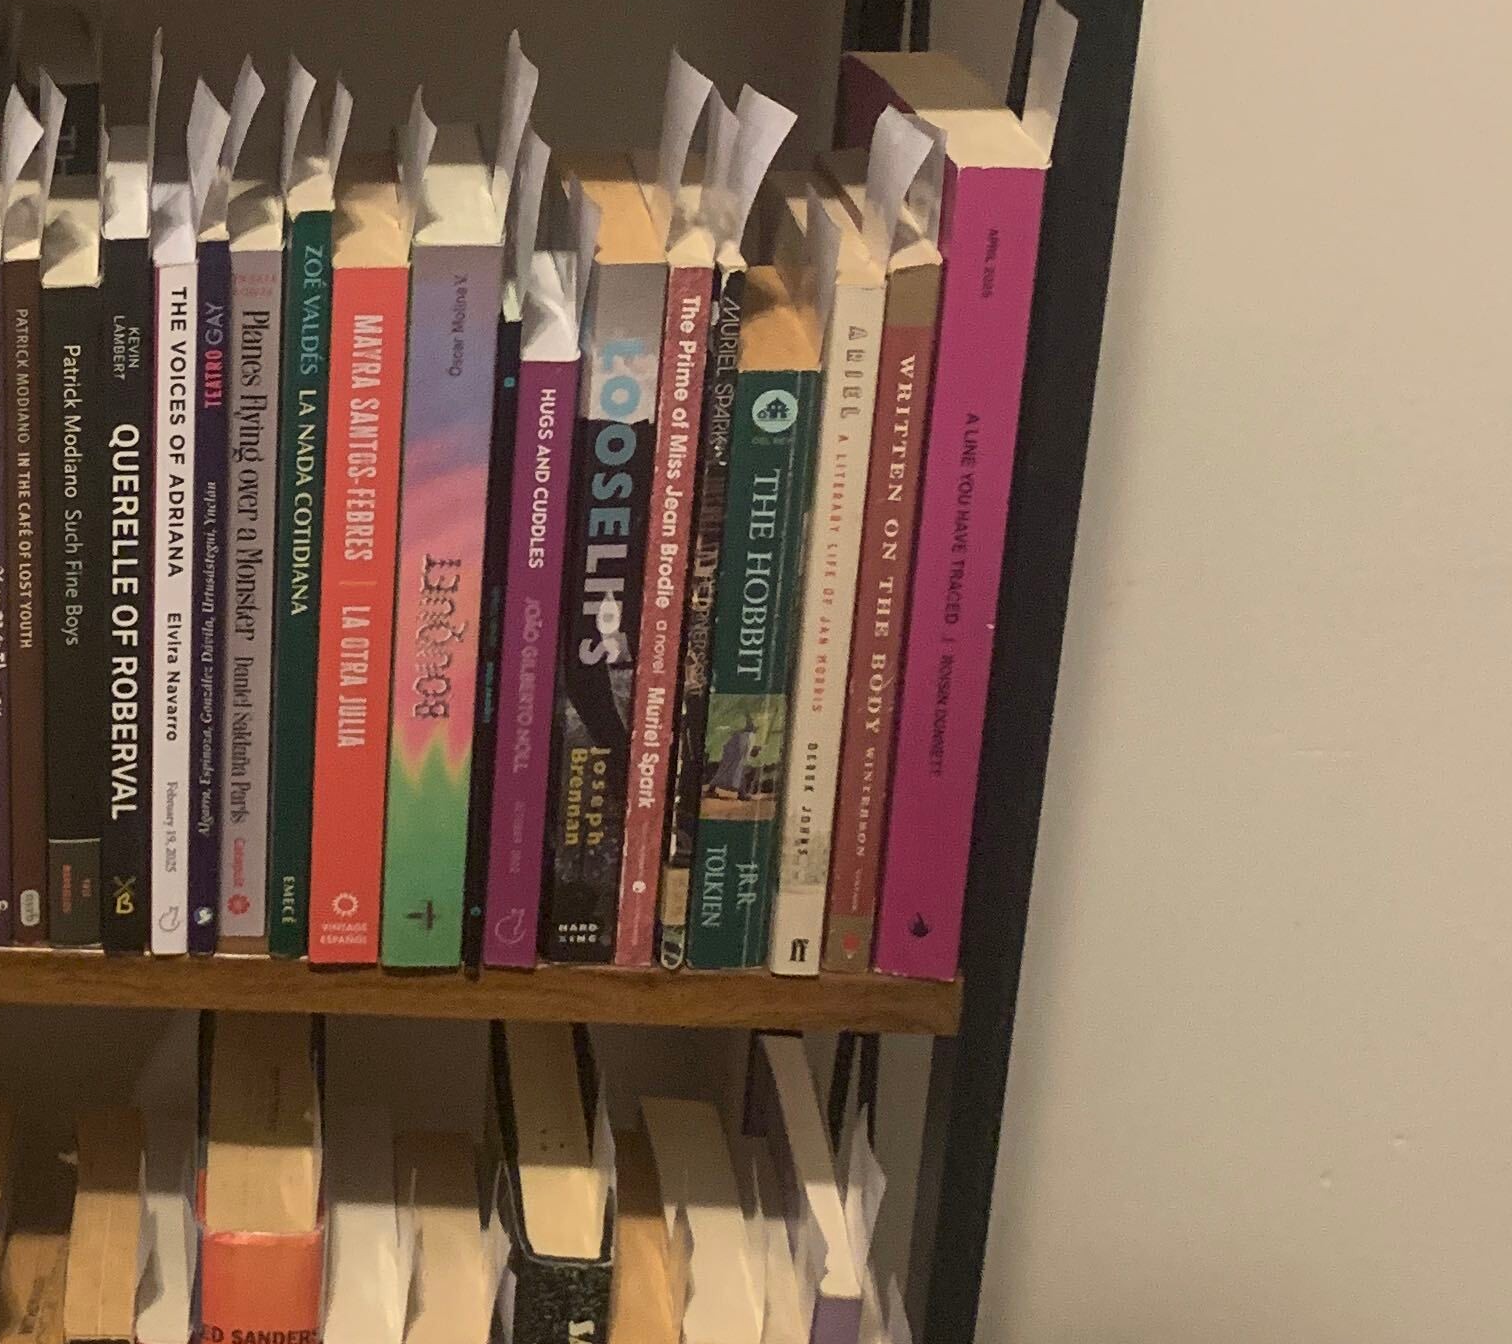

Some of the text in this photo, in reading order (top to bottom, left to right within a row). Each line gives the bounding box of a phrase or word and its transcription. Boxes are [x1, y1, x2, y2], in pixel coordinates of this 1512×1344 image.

[167, 286, 187, 578] THE VOICES OF ADRIANA
[735, 468, 781, 682] THE HOBBIT
[867, 353, 917, 734] WRITTEN ON THE BODY
[108, 423, 140, 822] QUERELLE OF ROBERVAL
[700, 844, 728, 930] TOLKIEN
